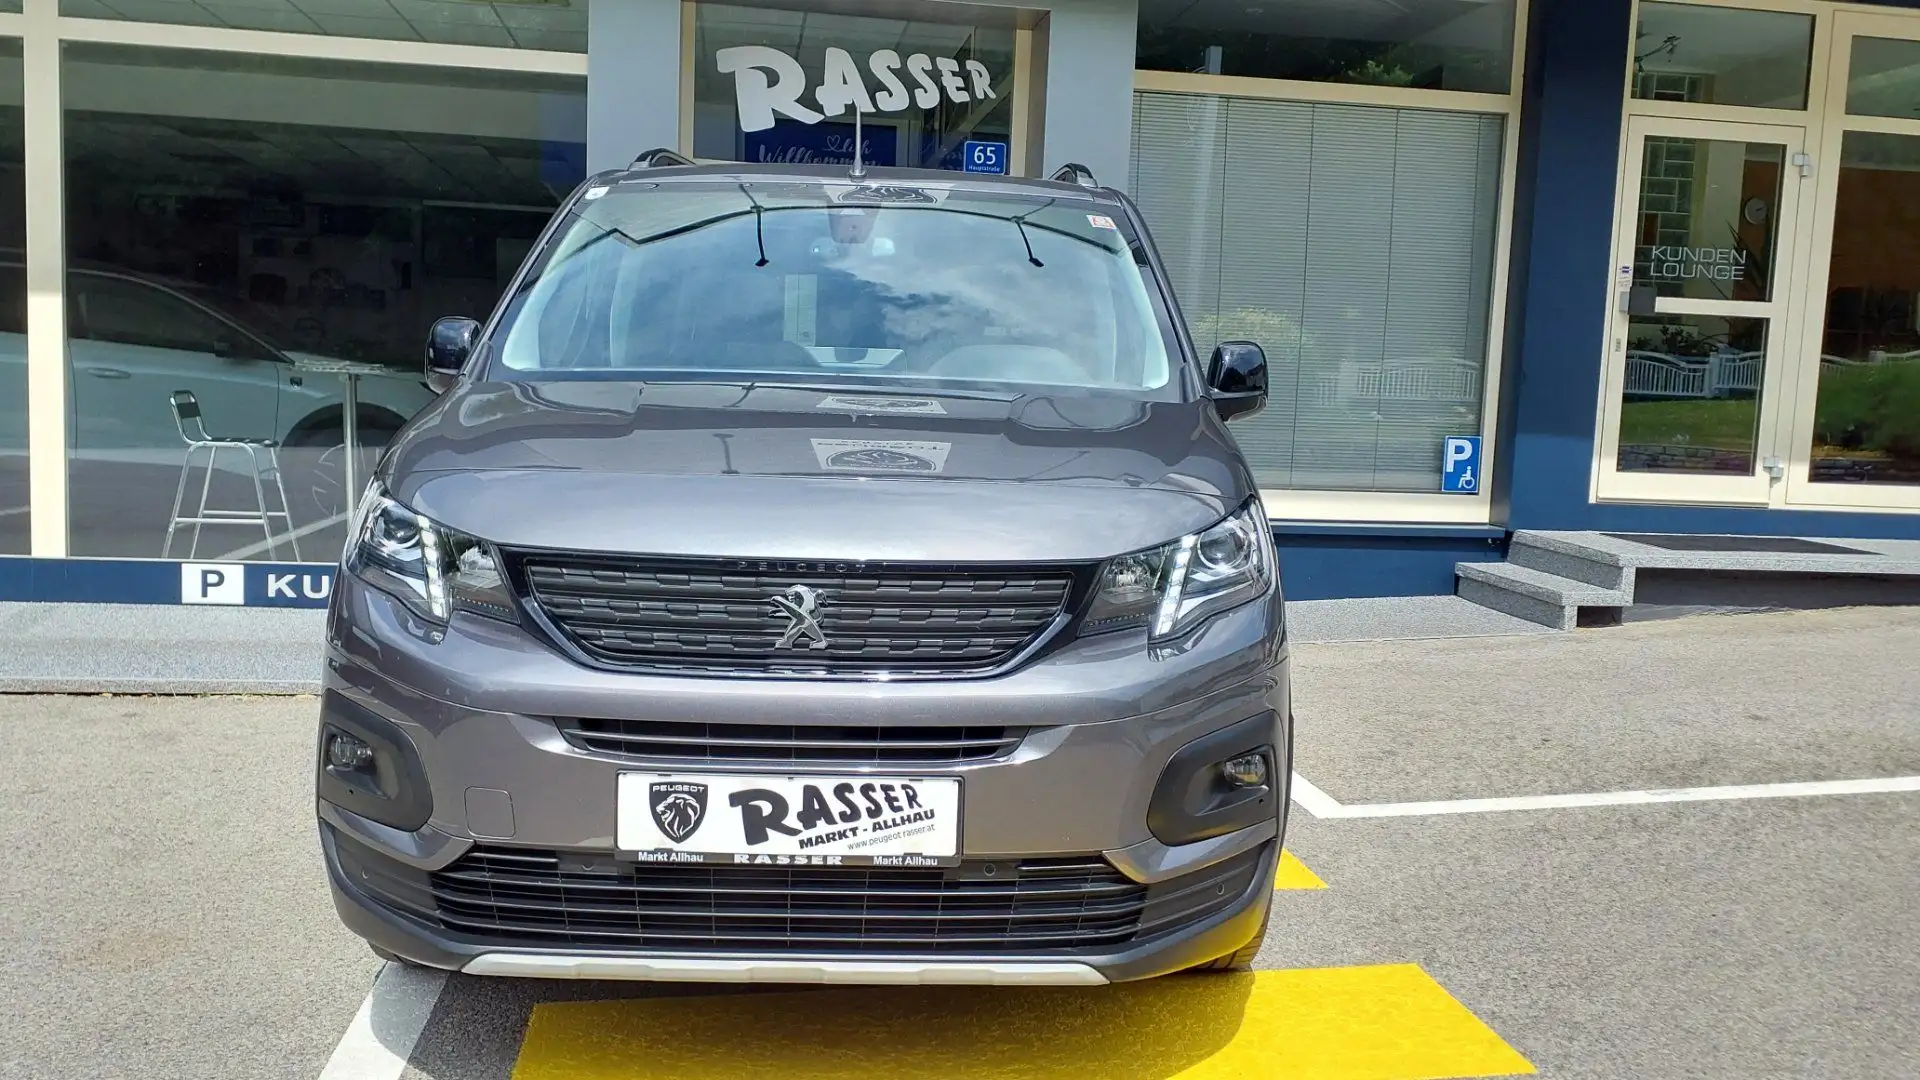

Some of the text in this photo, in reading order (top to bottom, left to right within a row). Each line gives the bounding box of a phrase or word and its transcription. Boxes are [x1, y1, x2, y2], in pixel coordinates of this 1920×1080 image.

[716, 46, 996, 132] RASSER
[974, 146, 996, 165] 65
[1651, 246, 1747, 264] KUNDEN
[1650, 263, 1745, 281] LOUNGE
[1446, 438, 1473, 472] P
[738, 561, 866, 573] PEUGEOT
[201, 569, 225, 598] P
[267, 573, 330, 599] KU
[652, 784, 705, 793] PEUGEOT
[728, 782, 923, 846] RASSER
[798, 826, 859, 850] MARKT
[872, 808, 936, 832] ALLHAU
[638, 851, 704, 863] Markt Allhau
[733, 853, 844, 866] RASSER
[873, 855, 938, 867] Markt Allhau
